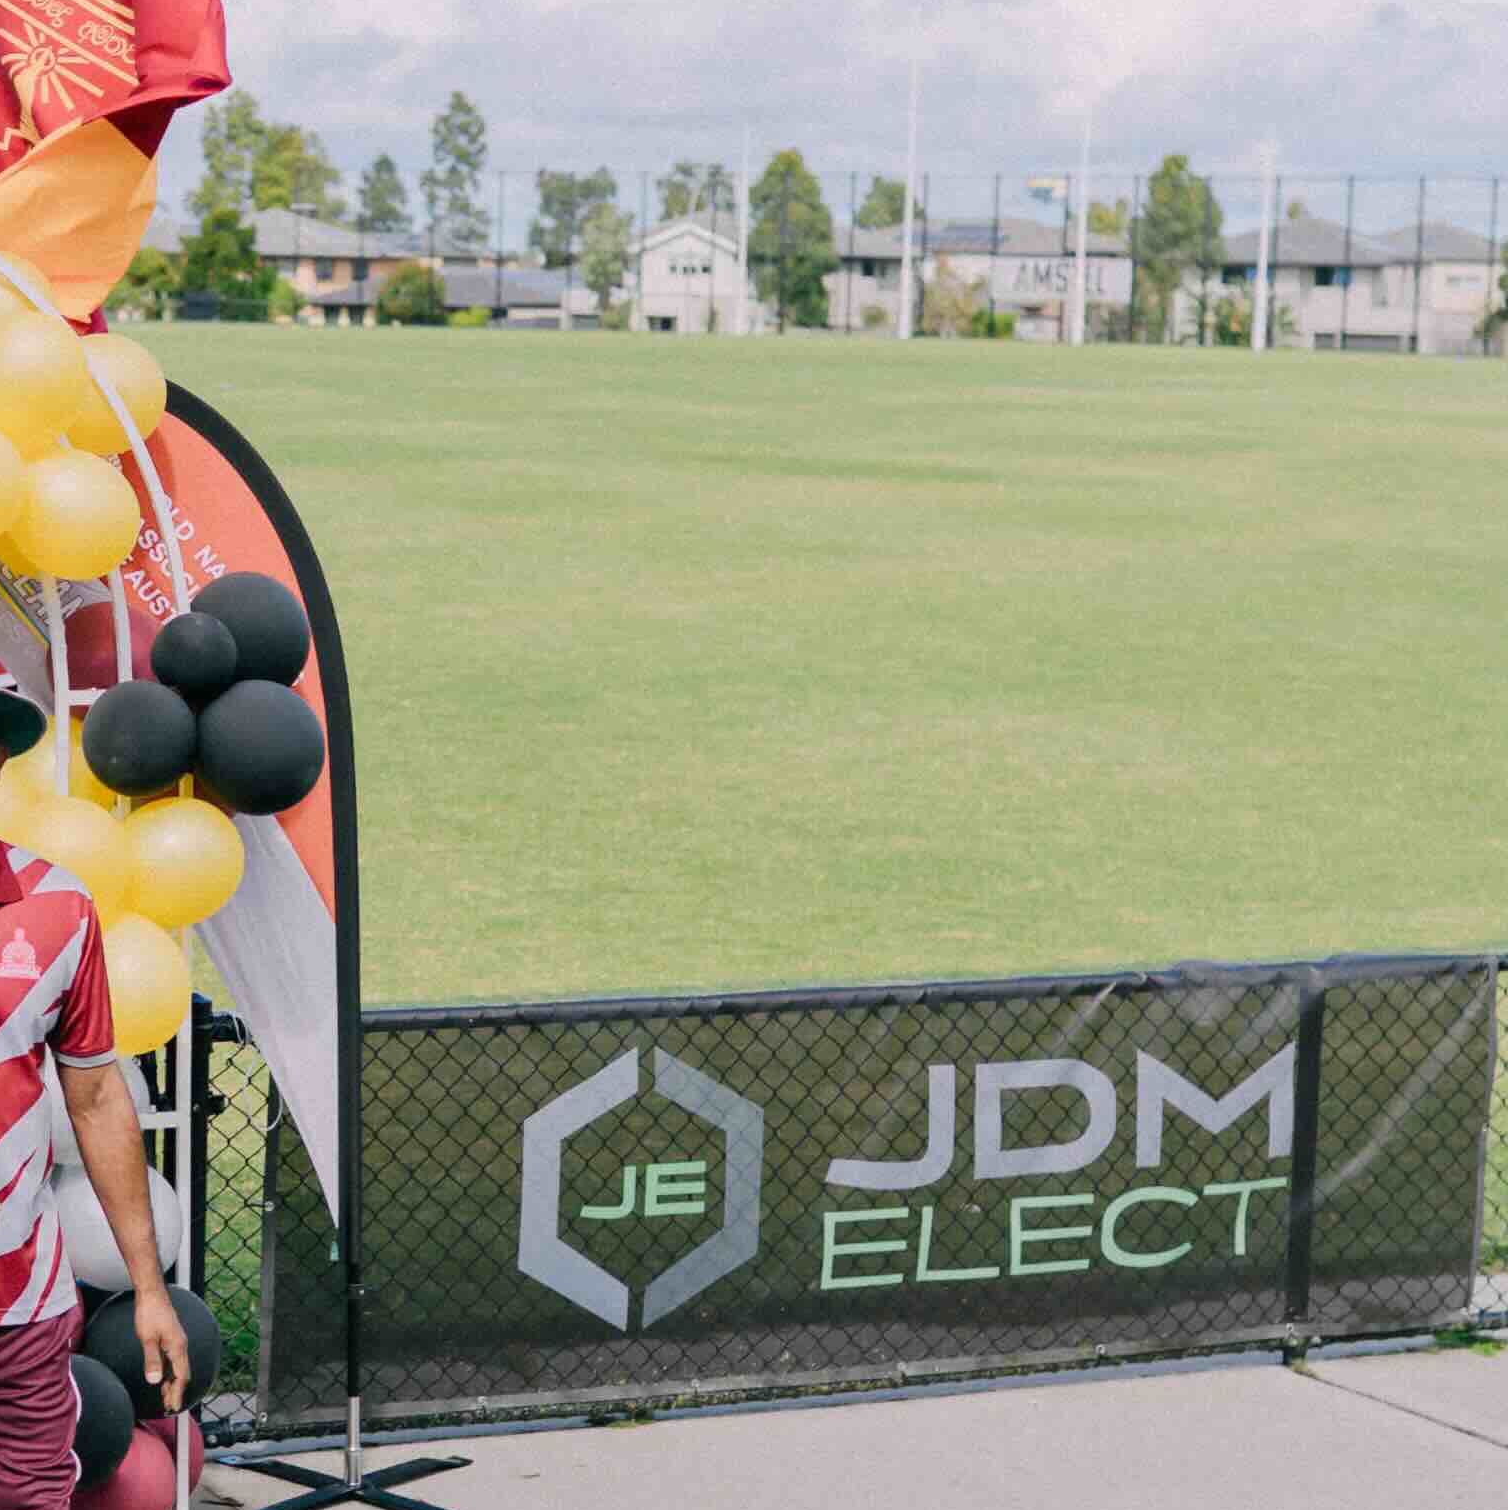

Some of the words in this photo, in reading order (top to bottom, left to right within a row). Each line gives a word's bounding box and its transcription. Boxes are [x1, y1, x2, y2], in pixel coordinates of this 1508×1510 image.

[824, 1041, 1296, 1190] JDM
[580, 1160, 707, 1220] JE
[820, 1176, 1288, 1290] ELECT
